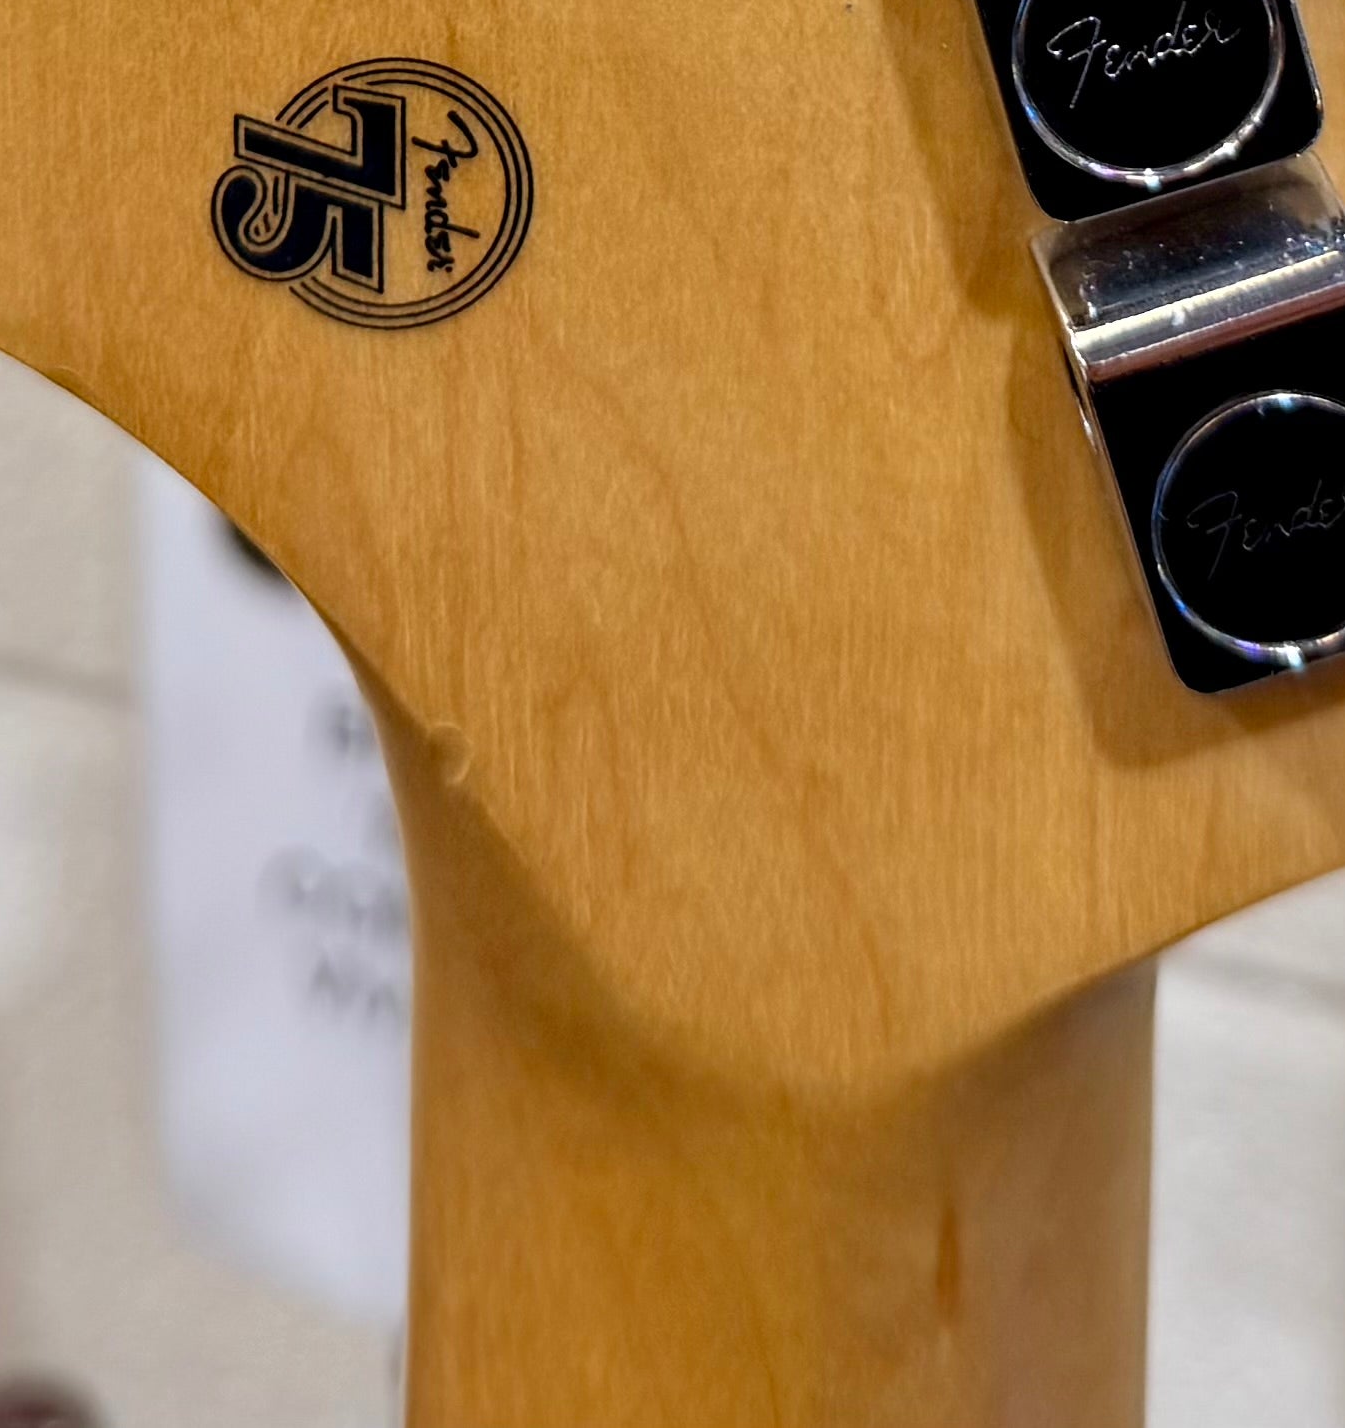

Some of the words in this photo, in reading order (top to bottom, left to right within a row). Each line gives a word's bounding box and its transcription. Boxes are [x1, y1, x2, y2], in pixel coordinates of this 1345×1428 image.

[1046, 0, 1241, 109] Fender
[210, 83, 407, 294] 75
[411, 110, 481, 273] Fender
